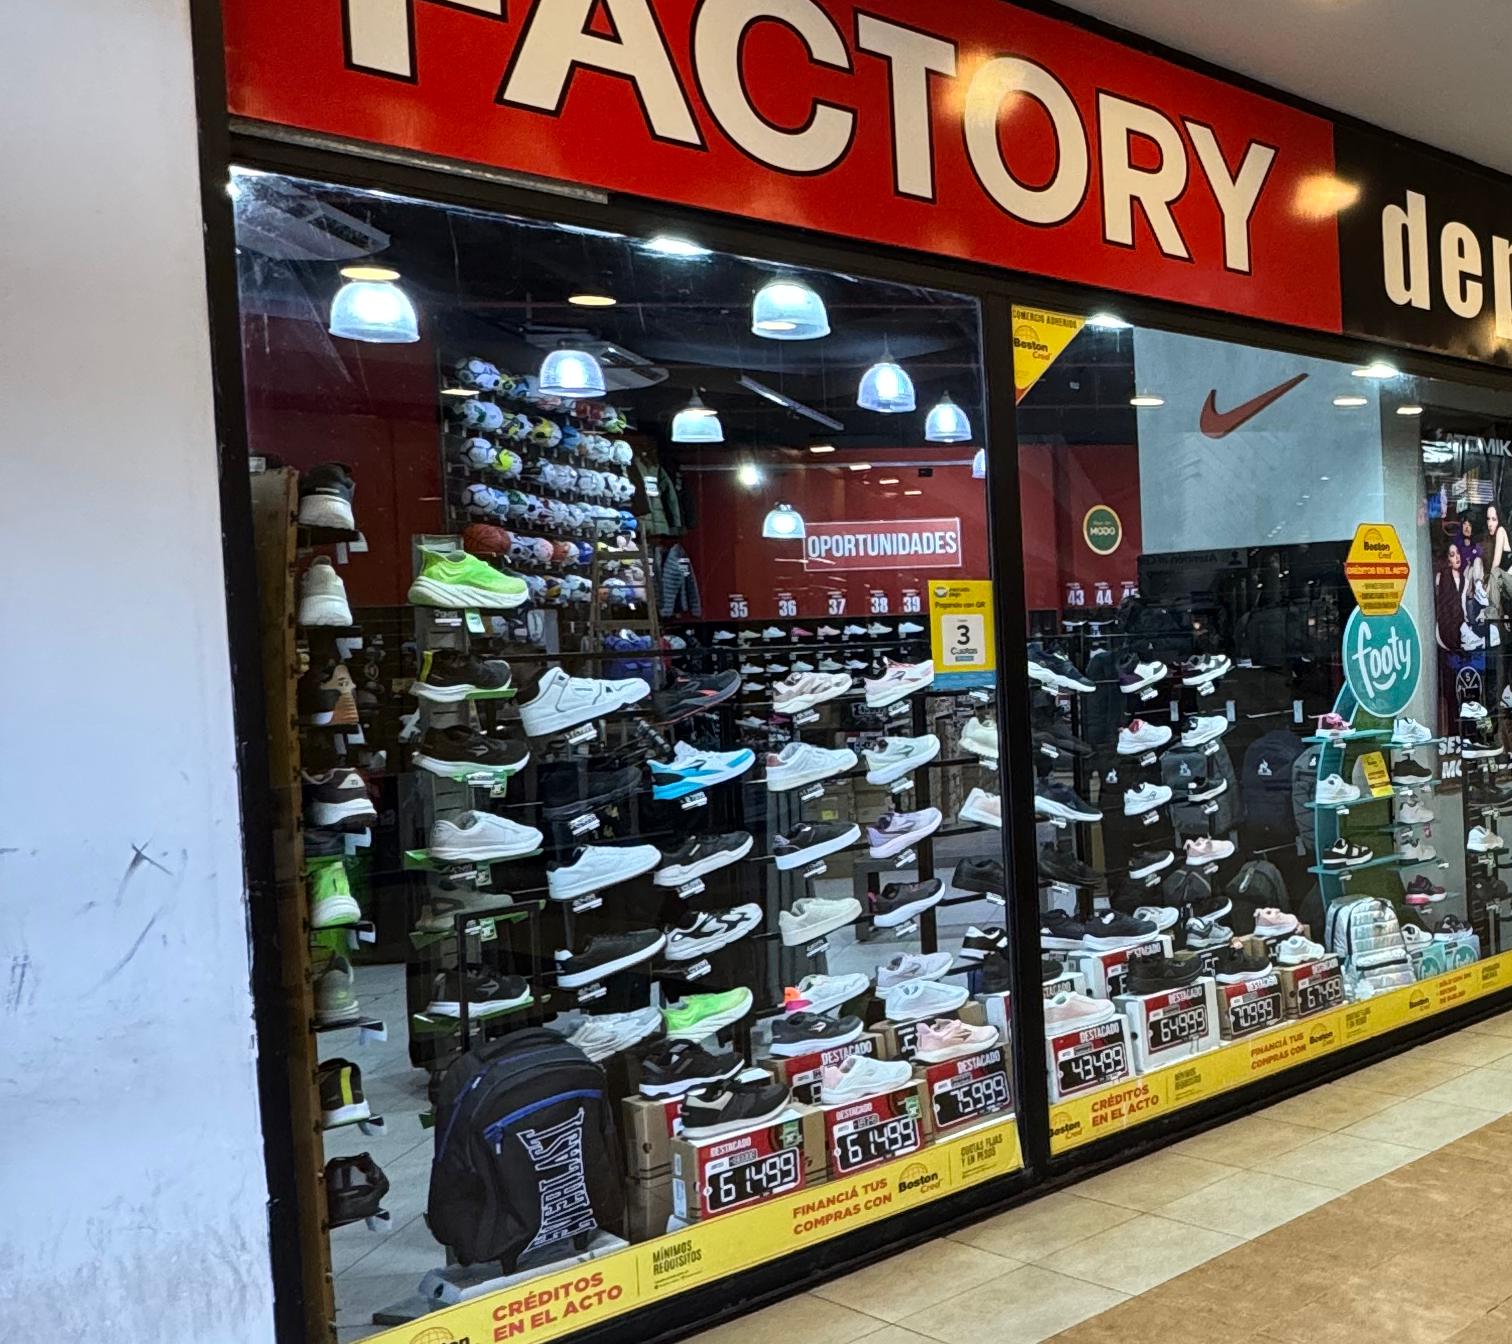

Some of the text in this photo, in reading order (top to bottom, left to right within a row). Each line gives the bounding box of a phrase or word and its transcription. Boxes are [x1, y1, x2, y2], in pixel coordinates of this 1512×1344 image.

[1013, 338, 1048, 352] Boston
[806, 530, 957, 557] OPORTUNIDADES
[730, 601, 748, 618] 35
[778, 600, 796, 616] 36
[828, 598, 846, 615] 37
[871, 597, 888, 613] 38
[903, 596, 920, 613] 39
[1067, 590, 1084, 606] 43
[1096, 590, 1113, 605] 44
[956, 625, 970, 645] 3
[1353, 621, 1412, 698] footy
[1160, 1008, 1206, 1042] 64999
[1233, 998, 1274, 1027] 70999
[1079, 1022, 1120, 1043] DESTACADO
[821, 1040, 872, 1066] DESTACADO
[957, 1050, 1001, 1074] DESTACADO
[1072, 1046, 1124, 1080] 43499
[951, 1074, 1009, 1113] 75999
[1091, 1084, 1149, 1113] CRÉDITOS
[1092, 1095, 1159, 1127] EN EL ACTO
[710, 1137, 751, 1157] DESTACADO
[847, 1118, 916, 1164] 61499
[720, 1152, 796, 1204] 61499
[898, 1171, 939, 1193] Boston
[792, 1177, 888, 1219] FINANCIÁ TUS
[793, 1192, 892, 1235] COMPRAS CON
[652, 1239, 693, 1264] MÍNIMOS
[653, 1248, 703, 1276] REQUISITOS
[492, 1271, 605, 1323] CRÉDITOS
[493, 1284, 623, 1343] EN EL ACTO
